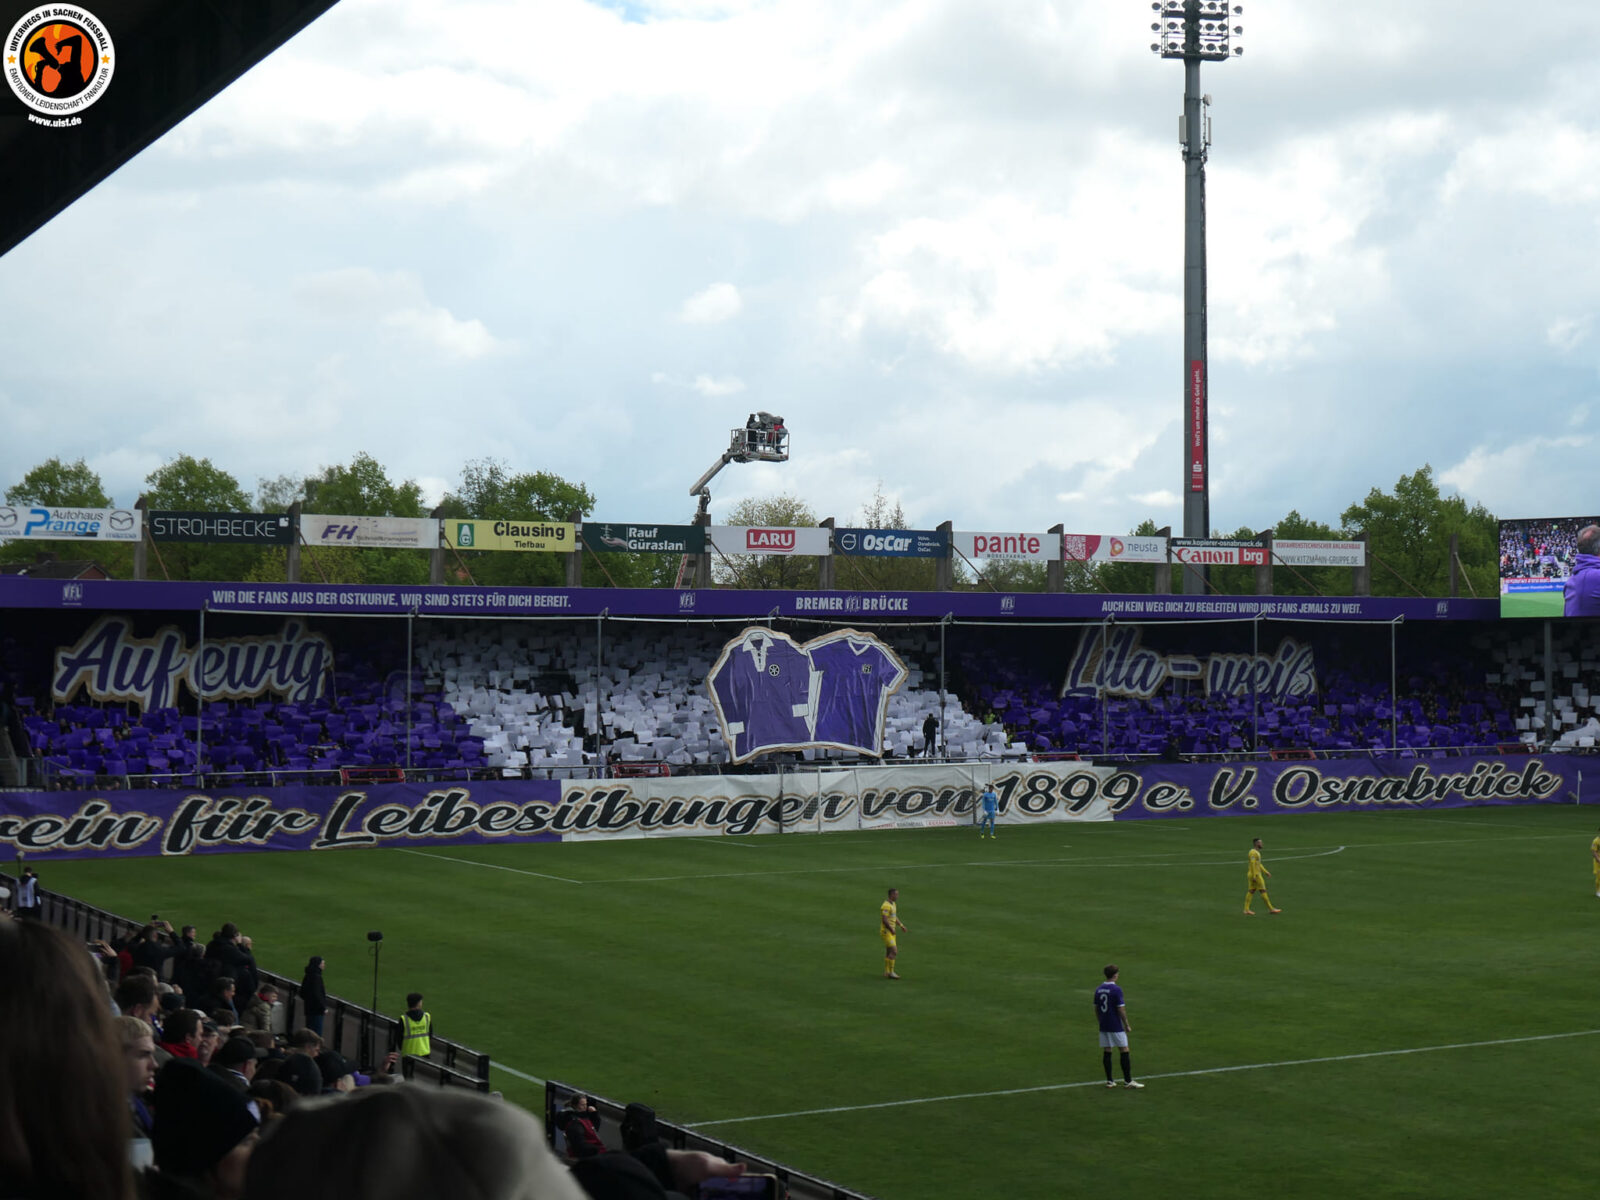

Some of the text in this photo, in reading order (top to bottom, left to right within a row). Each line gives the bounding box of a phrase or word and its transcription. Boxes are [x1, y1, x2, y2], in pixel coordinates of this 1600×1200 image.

[24, 509, 101, 536] Prange
[51, 509, 104, 521] Autohaus
[153, 517, 277, 538] STROHBECKE
[321, 524, 359, 540] FH
[493, 521, 566, 541] Clausing
[628, 527, 658, 539] Rauf
[514, 540, 546, 549] Tiefbau
[628, 539, 684, 551] Güraslan
[749, 531, 793, 547] LARU
[973, 533, 1041, 558] pante
[1127, 542, 1159, 553] neusta
[1177, 547, 1264, 565] Canon brg
[212, 590, 572, 608] WIR DIE FANS AUS DER OSTKURVE, WIR SIND STETS FÜR DICH BEREIT.
[795, 597, 844, 611] BREMER
[862, 595, 909, 611] BRÜCKE
[1101, 601, 1362, 614] AUCH KEIN WEG DICH ZU BEGLEITEN WIRD UNS FANS JEMALS ZU WEIT.
[54, 617, 333, 711] Auf ewig
[163, 797, 319, 854] für
[314, 788, 856, 848] Leibesübungen
[861, 786, 979, 818] von
[992, 771, 1142, 815] 1899
[1145, 783, 1193, 811] e.
[1211, 768, 1257, 809] V.
[1273, 761, 1561, 806] Osnabrück
[1099, 993, 1109, 1013] 3
